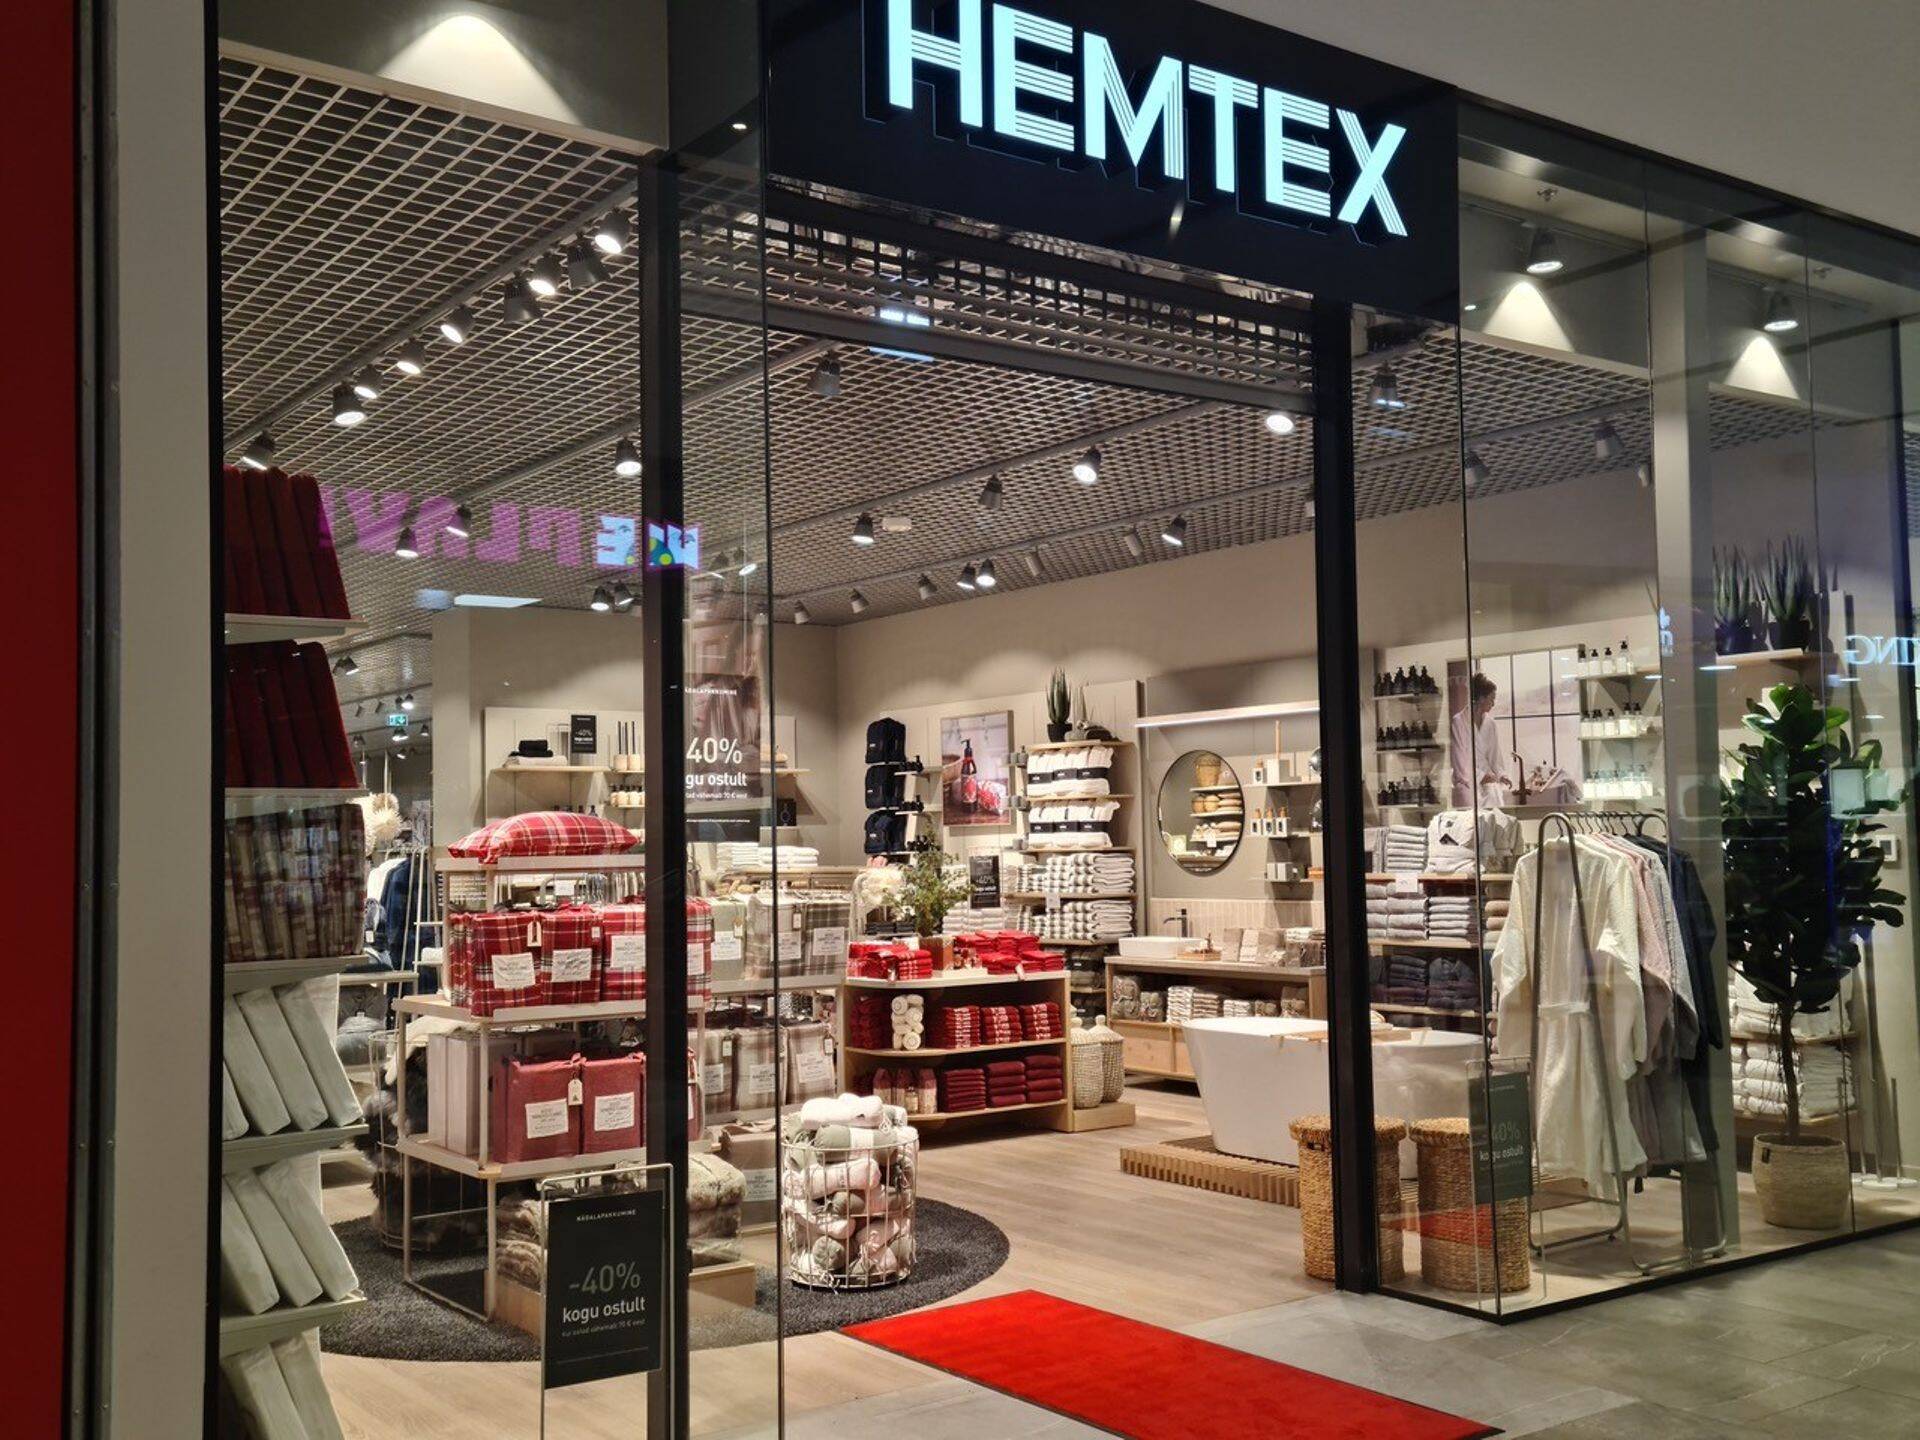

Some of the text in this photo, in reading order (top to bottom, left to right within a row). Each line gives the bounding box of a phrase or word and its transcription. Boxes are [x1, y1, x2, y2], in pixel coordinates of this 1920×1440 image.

[888, 0, 1408, 237] HEMTEX
[685, 771, 748, 789] gu ostult
[568, 1262, 641, 1295] -40%
[562, 1297, 646, 1324] kogu ostult
